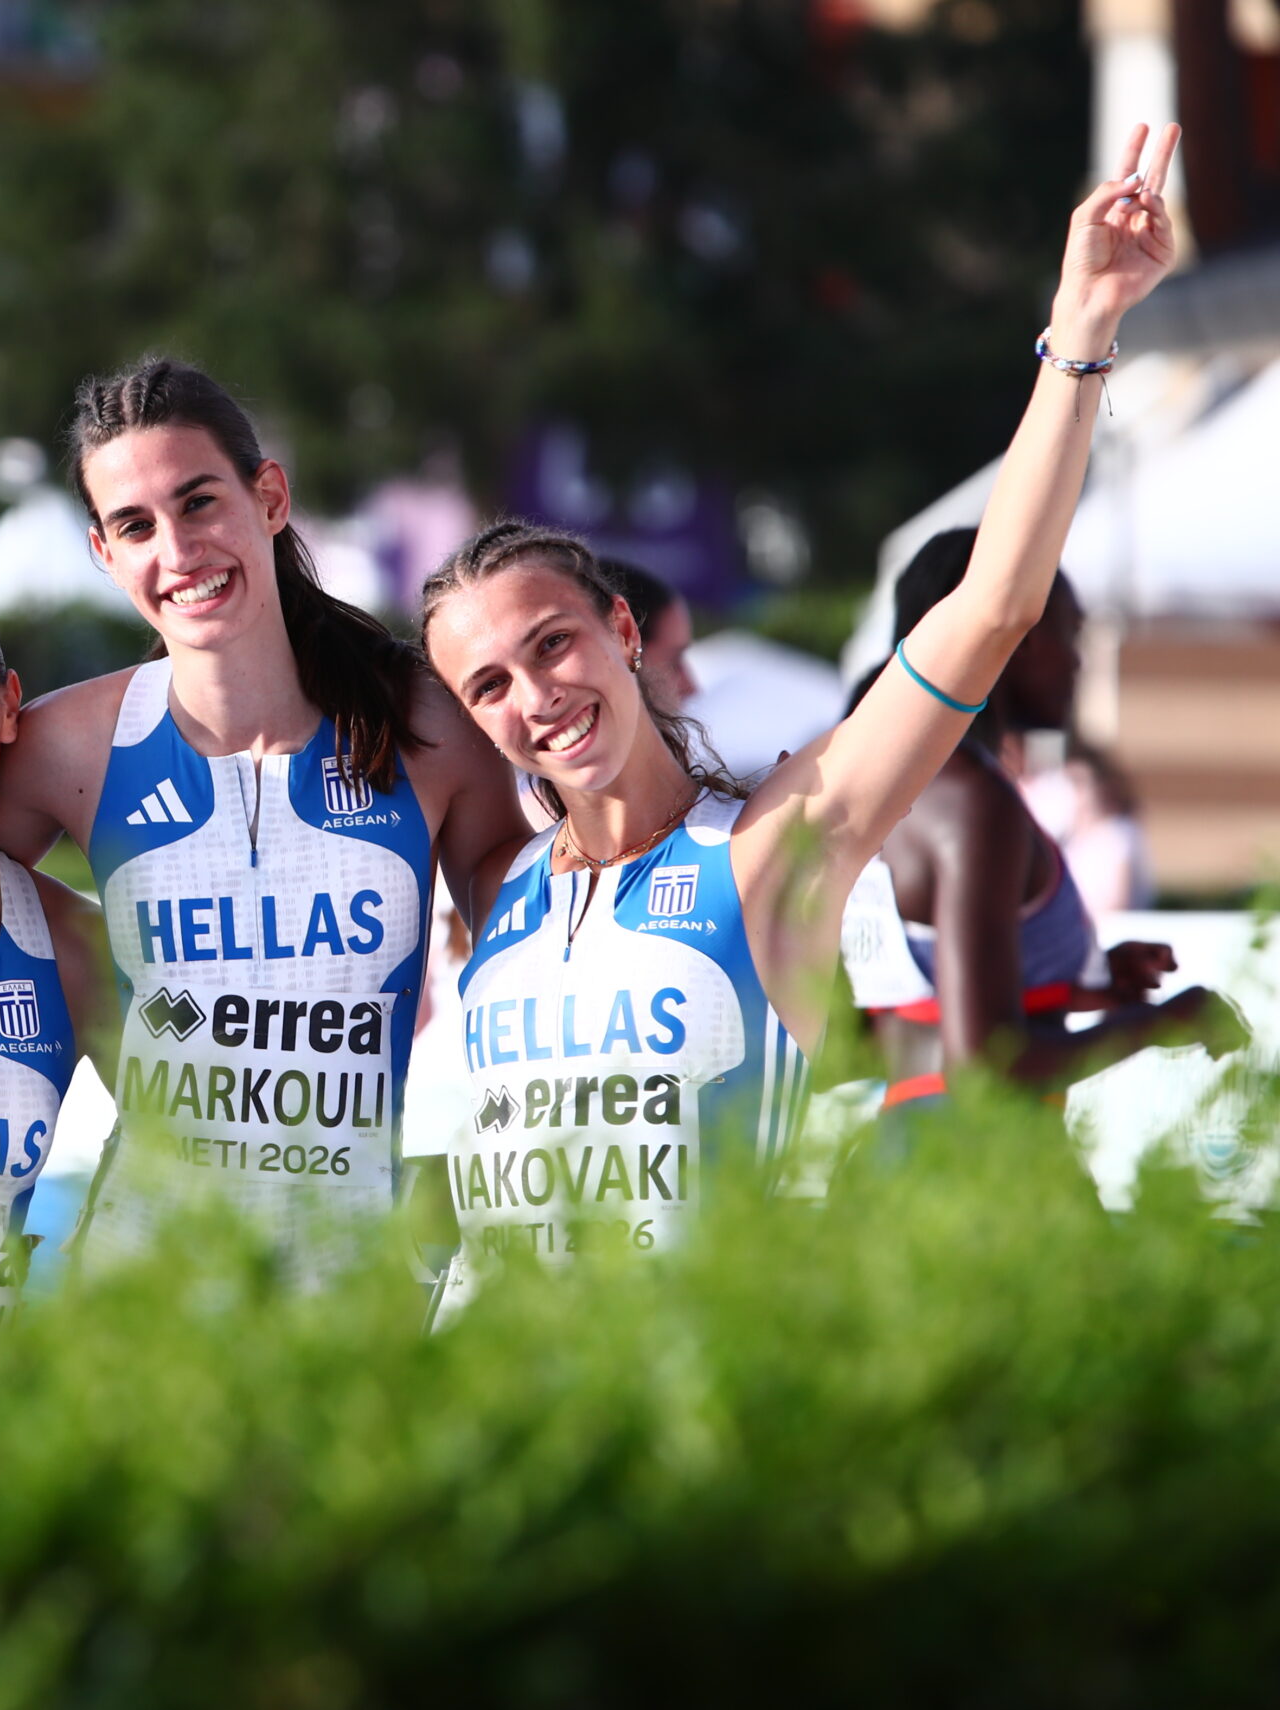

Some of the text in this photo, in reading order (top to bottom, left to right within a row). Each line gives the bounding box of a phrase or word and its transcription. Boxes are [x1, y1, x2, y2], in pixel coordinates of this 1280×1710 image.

[322, 814, 387, 830] AEGEAN
[136, 889, 384, 963] HELLAS
[636, 919, 703, 932] AEGEAN
[466, 987, 688, 1073] HELLAS
[122, 1056, 384, 1128] MARKOULI
[258, 1143, 350, 1176] 2026
[453, 1144, 688, 1210] IAKOVAKI
